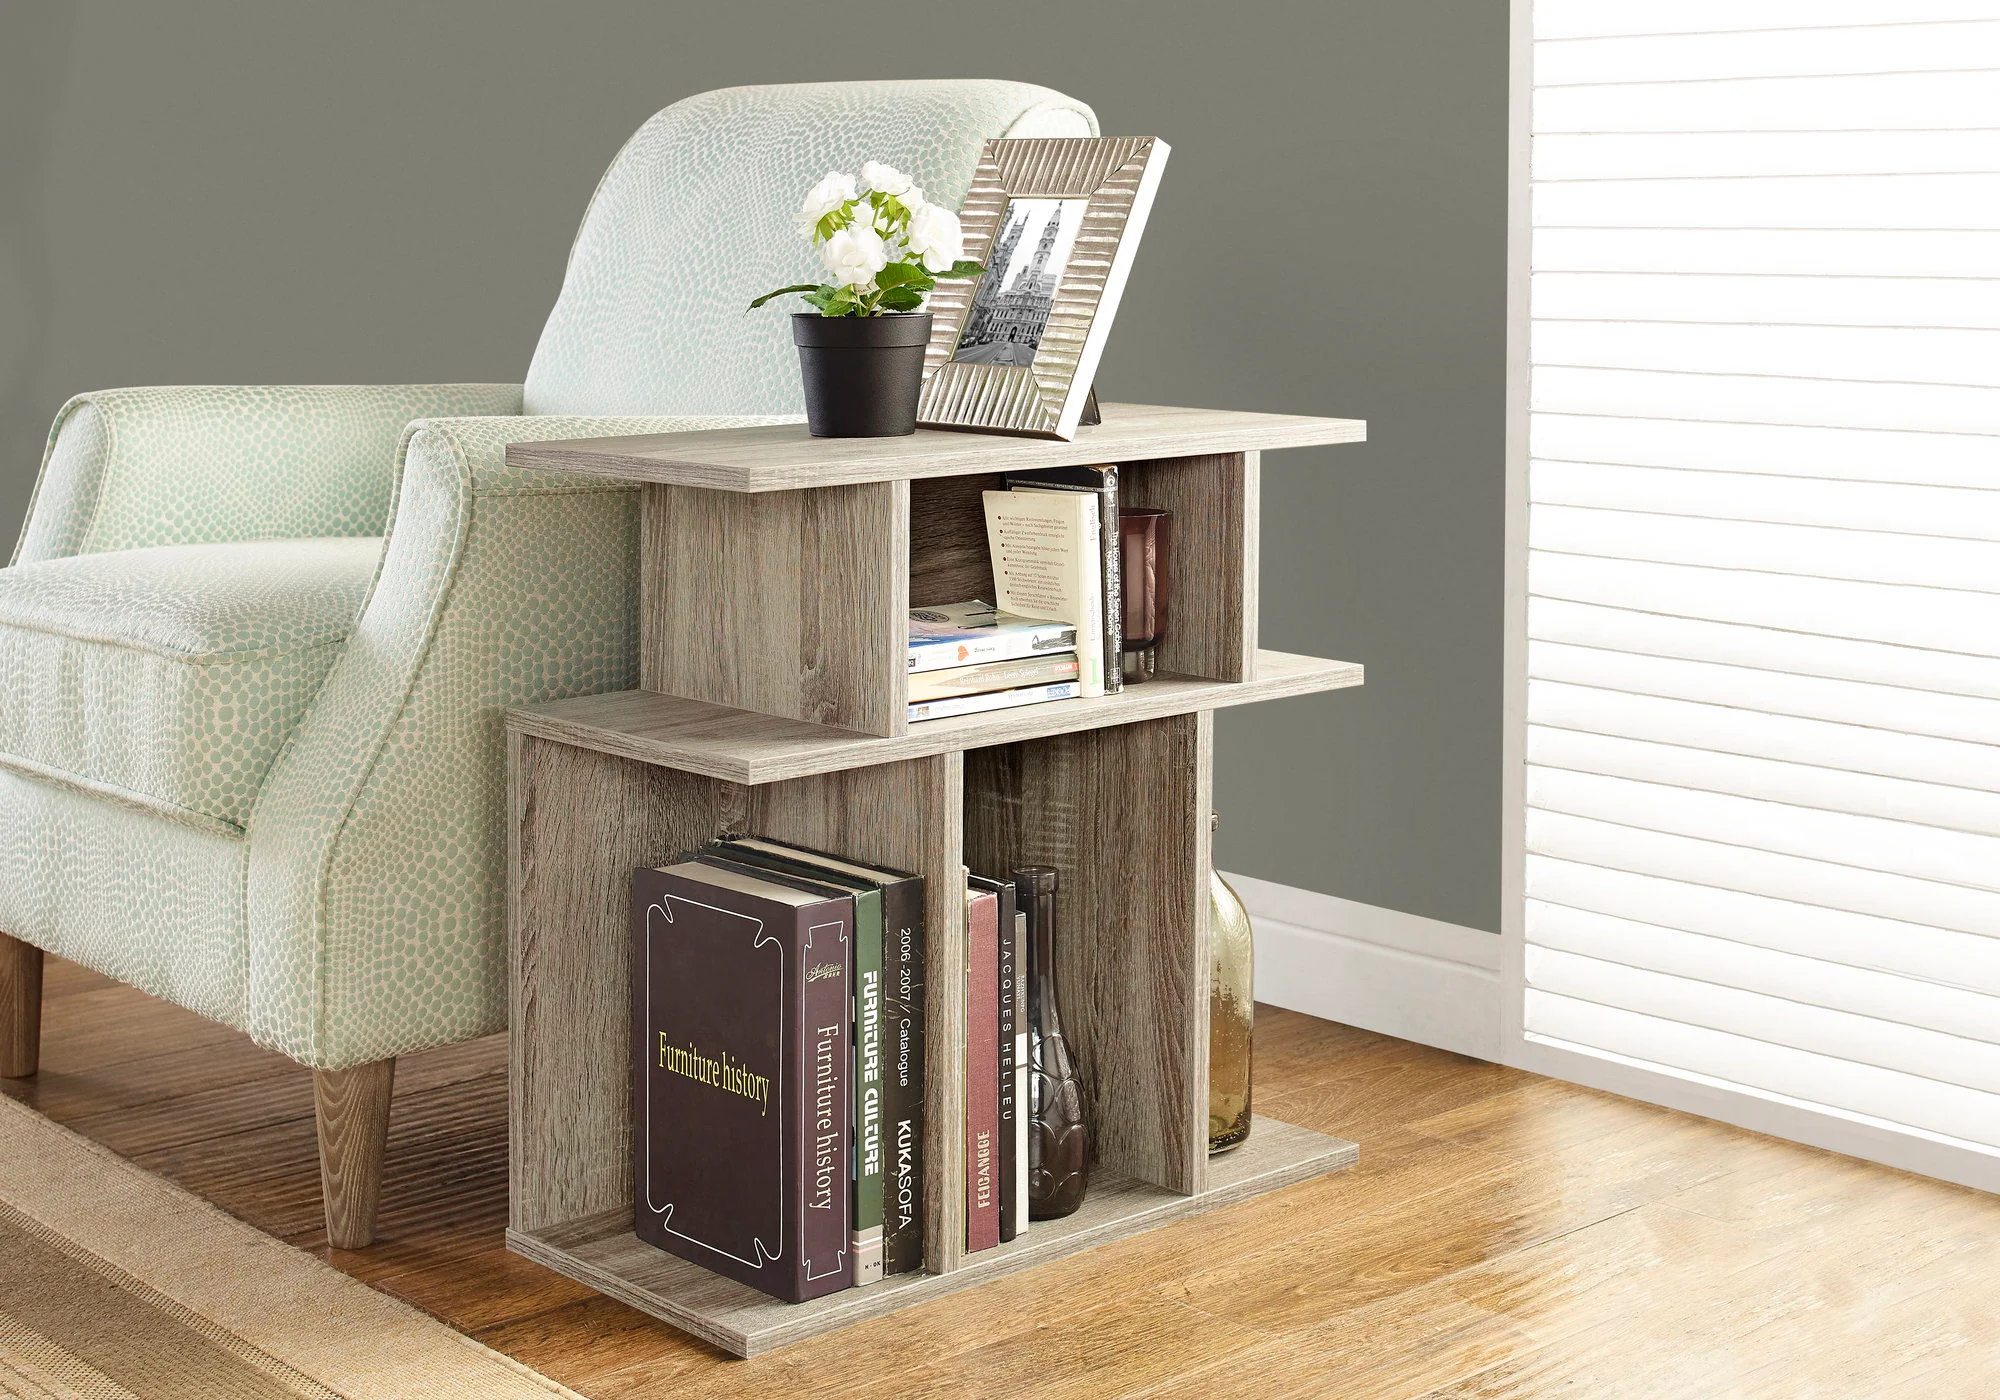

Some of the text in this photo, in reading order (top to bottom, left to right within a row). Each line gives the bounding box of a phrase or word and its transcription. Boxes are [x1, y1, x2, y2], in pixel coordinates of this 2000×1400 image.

[1113, 573, 1119, 583] of
[1113, 598, 1121, 622] Seven
[900, 927, 911, 962] 2006
[897, 1018, 911, 1087] Catalogue
[1002, 938, 1012, 1120] JACQUES HELLEU
[658, 1030, 770, 1117] Furniture history
[809, 1023, 839, 1211] Furniture history
[864, 1086, 880, 1176] CULTURE
[897, 1119, 912, 1230] KUKASOFA
